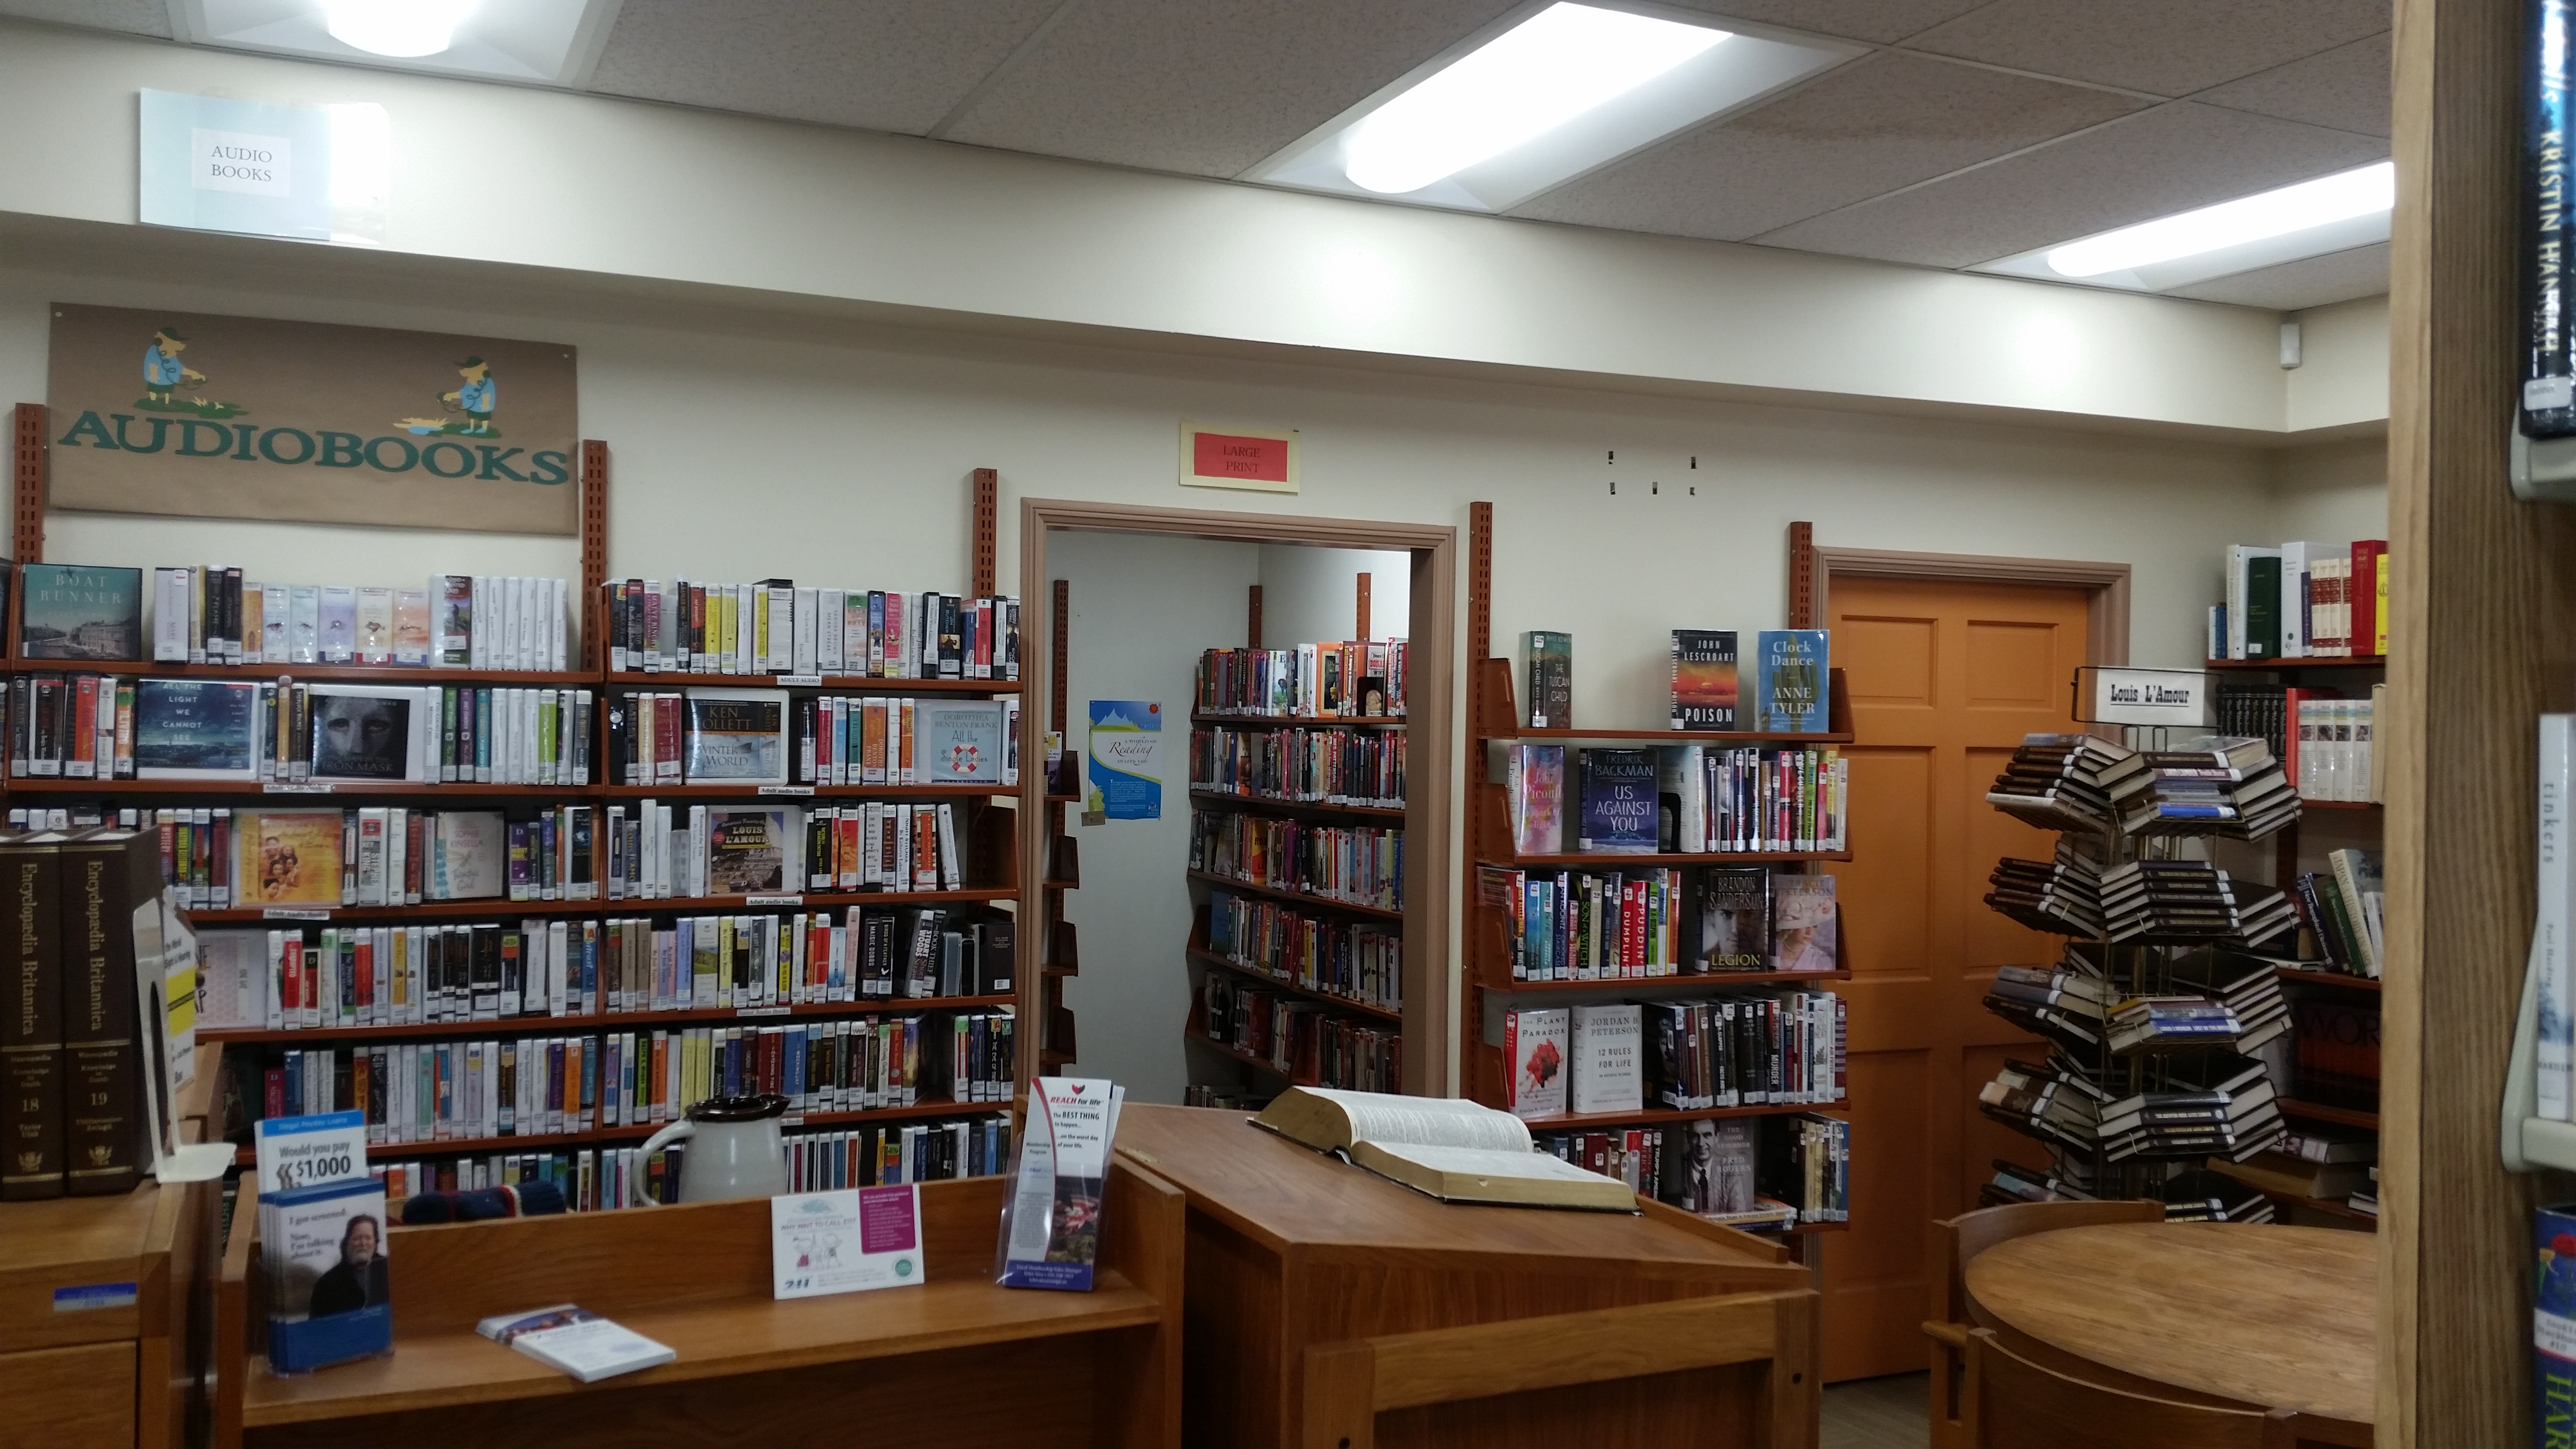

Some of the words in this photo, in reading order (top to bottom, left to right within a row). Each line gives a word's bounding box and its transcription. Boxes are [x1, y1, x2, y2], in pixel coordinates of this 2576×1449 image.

[210, 145, 272, 163] AUDIO
[210, 164, 272, 182] BOOKS
[2539, 129, 2562, 231] KRISTIN
[2536, 241, 2562, 354] HANNAH
[58, 410, 570, 486] AUDIOBOOKS
[1224, 446, 1261, 458] LARGE
[1226, 462, 1260, 473] PRINT
[56, 574, 106, 587] BOAT
[40, 590, 120, 604] RUNNER
[1697, 640, 1720, 649] JOHN
[1773, 641, 1811, 652] Clock
[1684, 652, 1734, 661] LESCROART
[1771, 655, 1814, 666] Dance
[1555, 663, 1563, 673] THE
[1549, 676, 1570, 687] TUSCAN
[1551, 691, 1567, 702] CHILD
[1772, 687, 1812, 698] ANNE
[2110, 684, 2138, 703] Louis
[2145, 685, 2190, 704] L'Amour
[709, 706, 739, 718] KEN
[1685, 708, 1733, 722] POISON
[1771, 703, 1815, 714] TYLER
[952, 730, 965, 742] All
[967, 730, 978, 742] the
[700, 745, 739, 755] WINTER
[1110, 741, 1153, 757] Reading
[706, 755, 748, 766] WORLD
[941, 750, 963, 764] Single
[966, 751, 988, 762] Ladies
[1606, 755, 1643, 764] FREDRIK
[322, 760, 353, 770] IRON
[358, 762, 393, 772] MASK
[1595, 765, 1654, 776] BACKMAN
[1534, 770, 1553, 784] Jodi
[1525, 783, 1562, 800] Picoult
[1614, 785, 1633, 800] US
[1595, 801, 1652, 816] AGAINST
[732, 826, 762, 835] LOUIS
[1534, 820, 1551, 828] light
[1610, 817, 1638, 831] YOU
[2542, 782, 2560, 865] tinkers
[725, 835, 770, 844] L'AMOUR
[361, 853, 370, 871] KING
[457, 878, 475, 891] Girl
[1718, 877, 1755, 891] BRANDON
[1781, 888, 1833, 896] PETERSON
[2334, 857, 2349, 885] JAPAN
[2345, 895, 2362, 933] HISTORY
[1710, 892, 1765, 910] SANDERSON
[915, 929, 927, 957] WOODS
[921, 929, 933, 958] STUART
[930, 930, 939, 950] BOOK
[1580, 933, 1588, 966] WITCH
[927, 952, 936, 974] THIEF
[1711, 954, 1760, 966] LEGION
[22, 961, 38, 1035] Britannica
[90, 956, 105, 1031] Britannica
[1591, 1017, 1629, 1026] JORDAN
[1522, 1029, 1565, 1037] PARADOX
[1591, 1027, 1638, 1036] PETERSON
[1770, 1054, 1779, 1085] MURDER
[22, 1097, 39, 1112] 18
[91, 1092, 107, 1106] 19
[1063, 1111, 1078, 1119] BEST
[1080, 1112, 1099, 1121] THING
[279, 1143, 311, 1158] Would
[313, 1144, 331, 1157] you
[332, 1142, 350, 1154] pay
[296, 1156, 351, 1181] $1,000
[784, 1278, 810, 1289] 211
